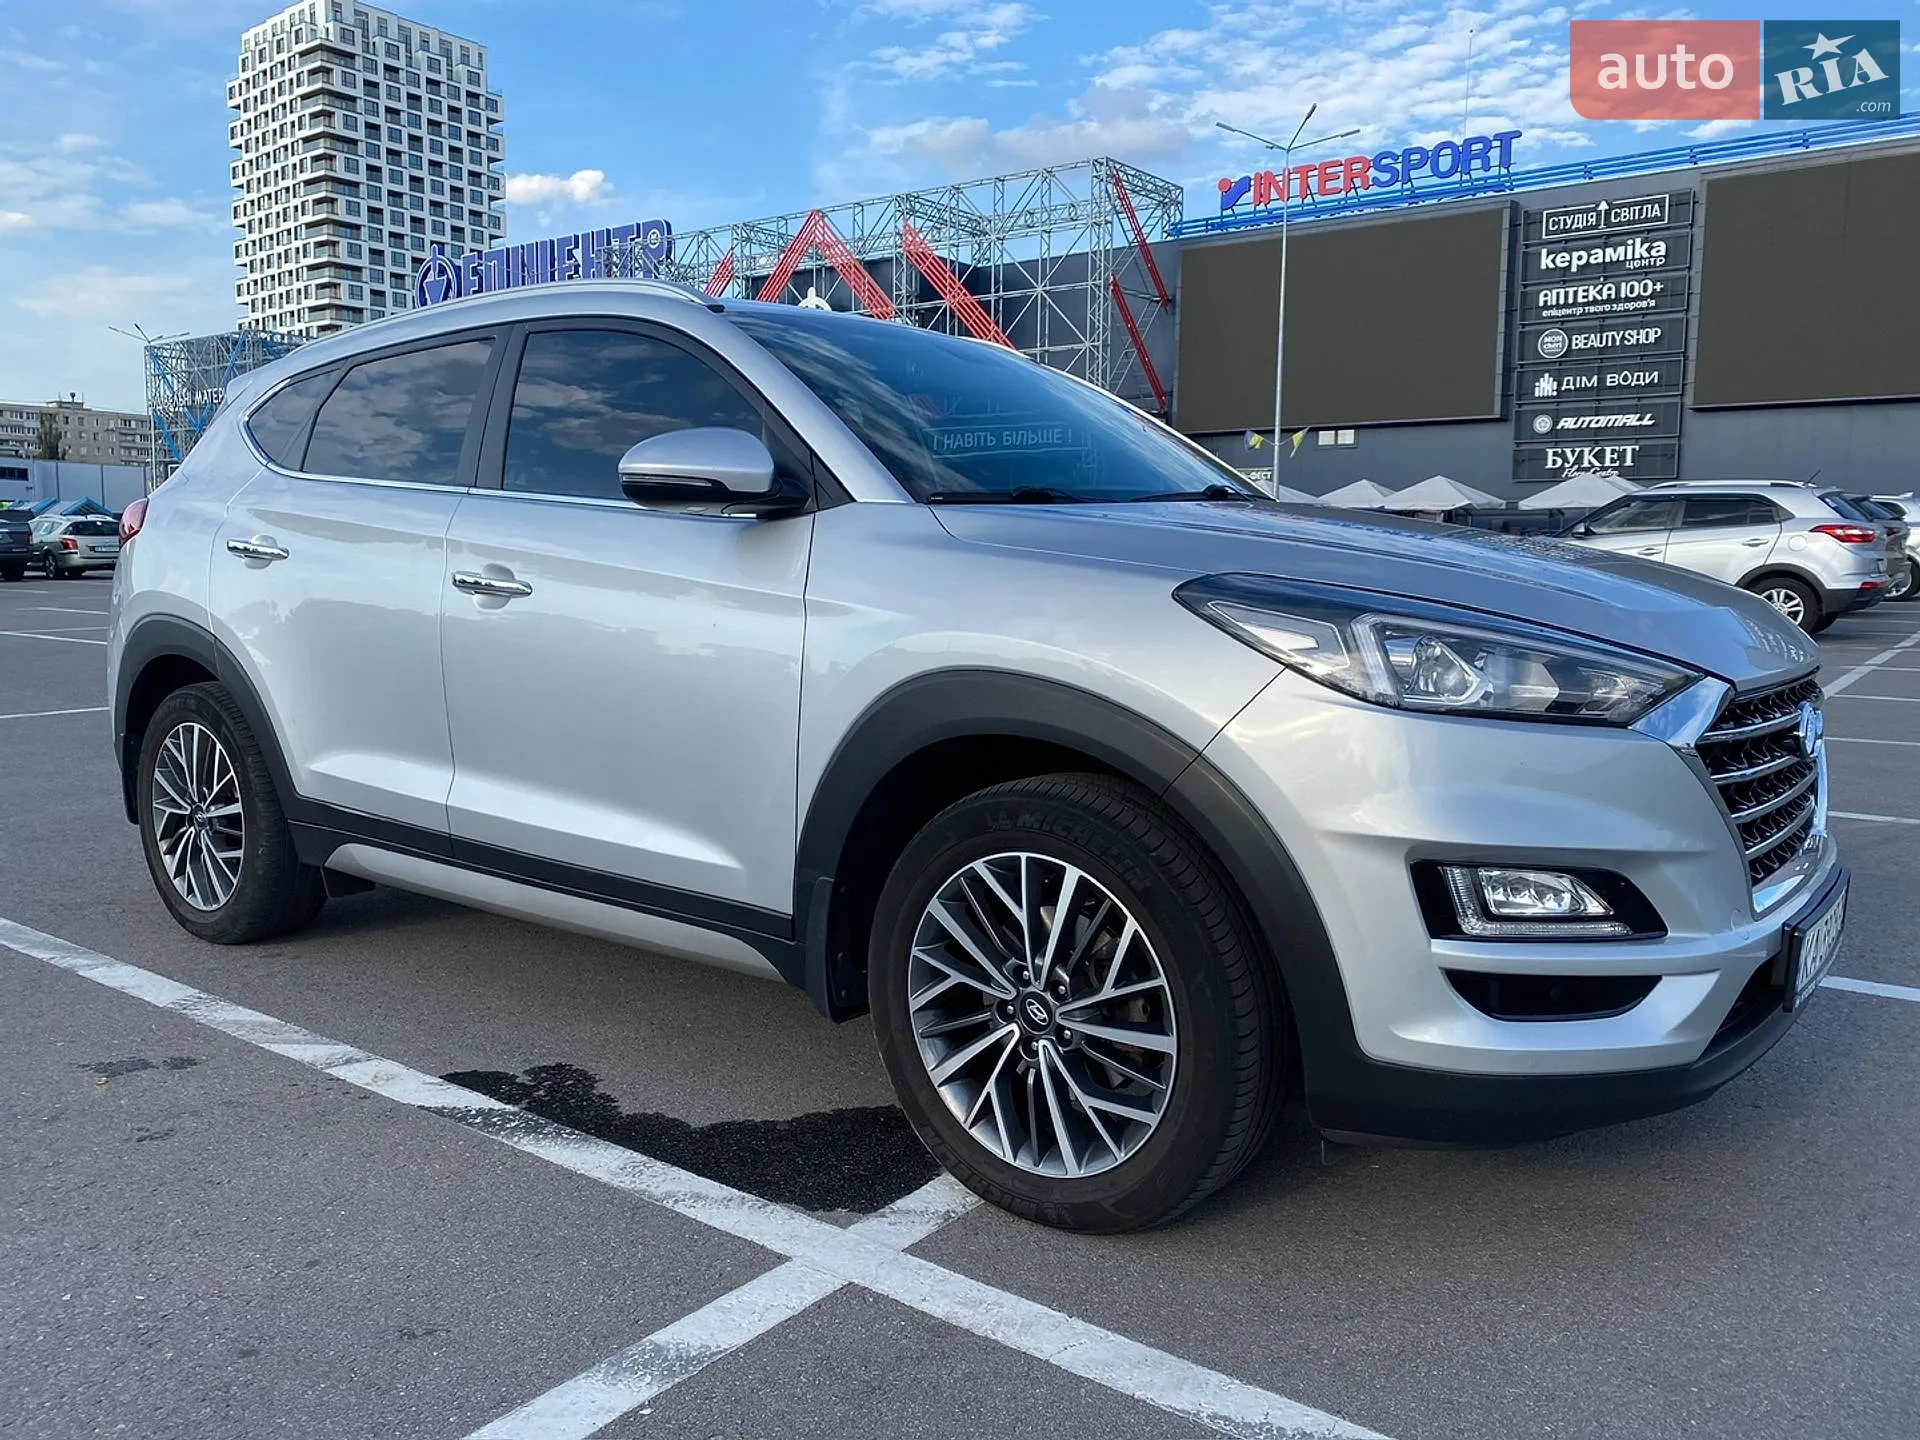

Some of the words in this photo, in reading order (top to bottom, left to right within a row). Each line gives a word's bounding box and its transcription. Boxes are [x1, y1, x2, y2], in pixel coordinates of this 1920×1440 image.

[1253, 129, 1523, 206] INTERSPORT
[1549, 212, 1597, 231] СТУДІЯ
[1610, 203, 1662, 223] СВІТЛА
[1538, 282, 1616, 307] АПТЕКА
[1619, 279, 1664, 298] 100+
[1571, 331, 1624, 350] BEAUTY
[1624, 327, 1662, 345] SHOP
[1561, 375, 1598, 391] ДІМ
[1606, 370, 1659, 387] ВОДИ
[1556, 413, 1656, 430] AUTOMALL
[943, 431, 996, 449] НАВІТЬ
[1002, 428, 1063, 446] БІЛЬШЕ
[1545, 445, 1640, 469] БУКЕТ
